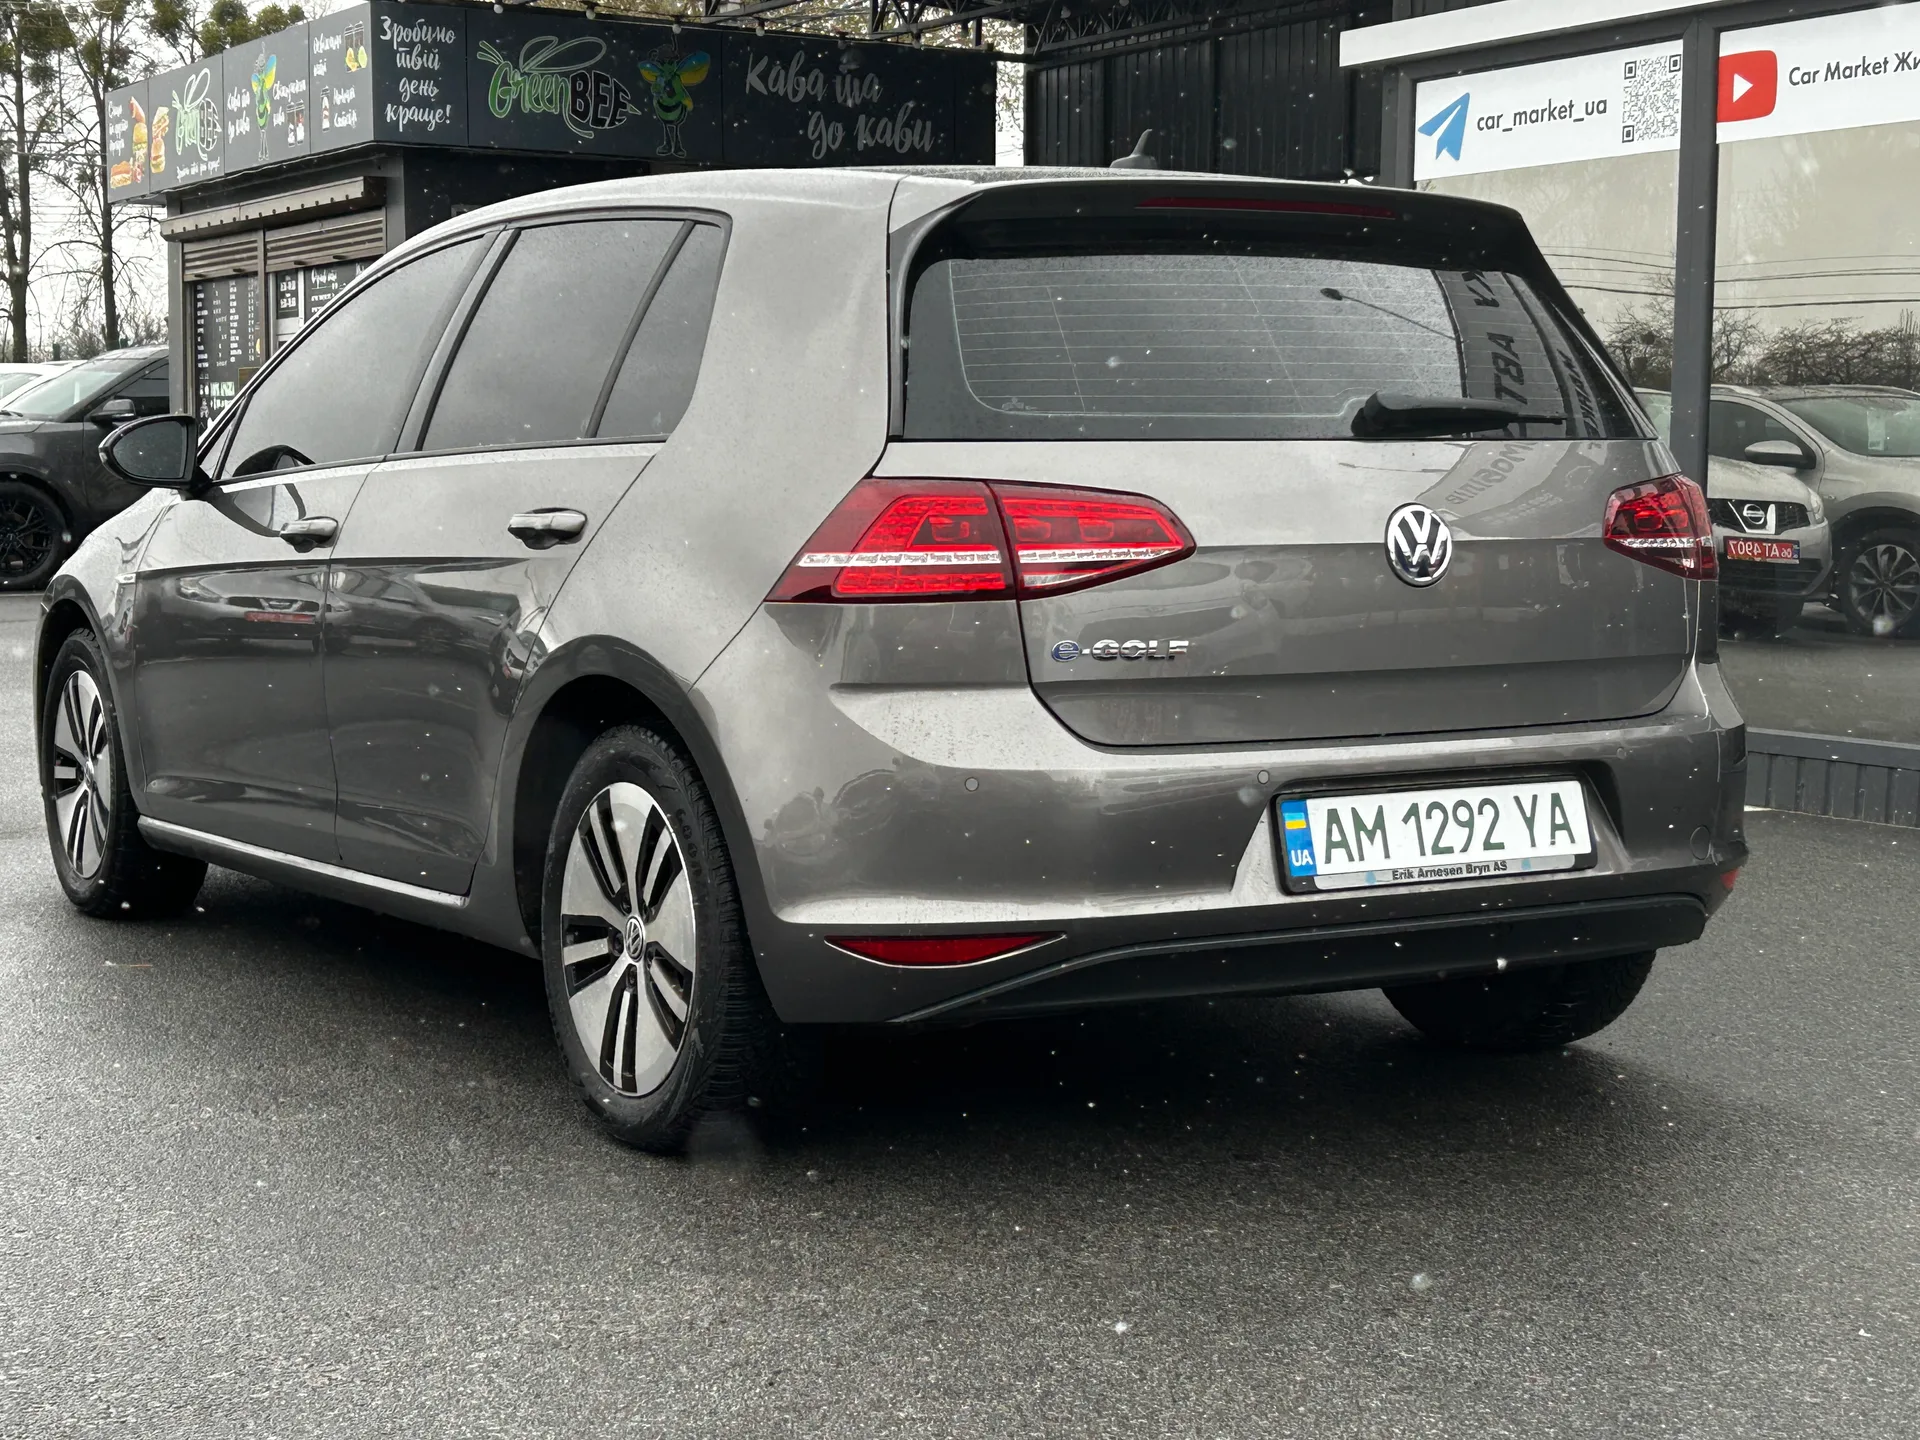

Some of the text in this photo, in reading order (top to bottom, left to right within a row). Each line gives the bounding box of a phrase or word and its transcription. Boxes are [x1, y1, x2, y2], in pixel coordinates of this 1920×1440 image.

[380, 16, 456, 50] Зробимо
[396, 44, 441, 70] твій
[1789, 66, 1820, 86] Car
[1824, 55, 1889, 82] Market
[399, 77, 439, 103] день
[746, 51, 828, 102] Кава
[384, 104, 452, 132] краще!
[1476, 98, 1608, 132] car_market_ua
[808, 101, 935, 159] до кави
[1051, 639, 1190, 662] e-GOLF
[1324, 792, 1576, 865] AM 1292 YA
[1291, 849, 1313, 867] UA
[1392, 868, 1414, 880] Erik
[1466, 863, 1491, 876] Bryn
[1493, 860, 1508, 873] AS
